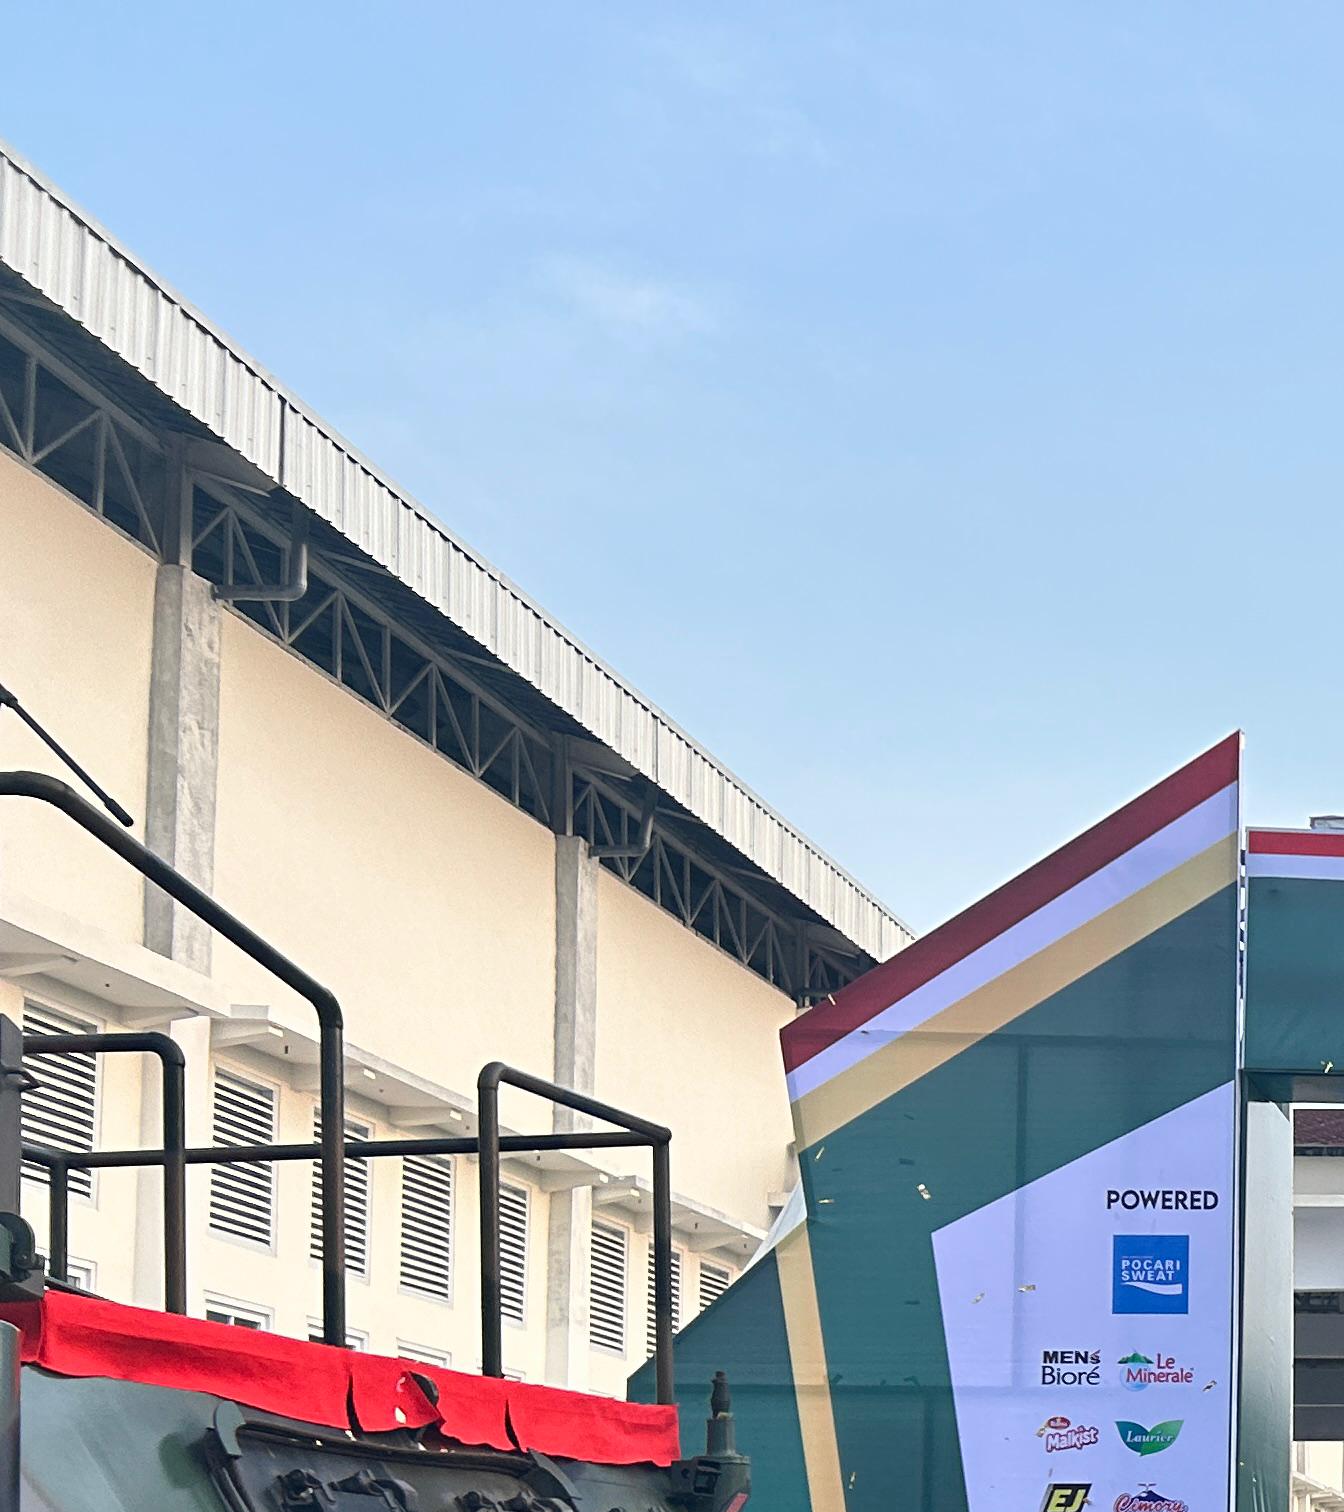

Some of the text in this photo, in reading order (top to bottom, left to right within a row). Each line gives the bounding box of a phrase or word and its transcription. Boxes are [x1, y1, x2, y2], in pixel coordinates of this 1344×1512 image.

[1106, 1190, 1218, 1210] POWERED
[1121, 1259, 1180, 1271] POCARI
[1121, 1270, 1175, 1282] SWEAT
[1156, 1353, 1175, 1370] Le
[1041, 1366, 1100, 1385] Bioré
[1127, 1369, 1190, 1383] Minerale
[1046, 1426, 1099, 1452] Malkist
[1126, 1430, 1175, 1443] Laurier
[1047, 1489, 1086, 1512] EJ
